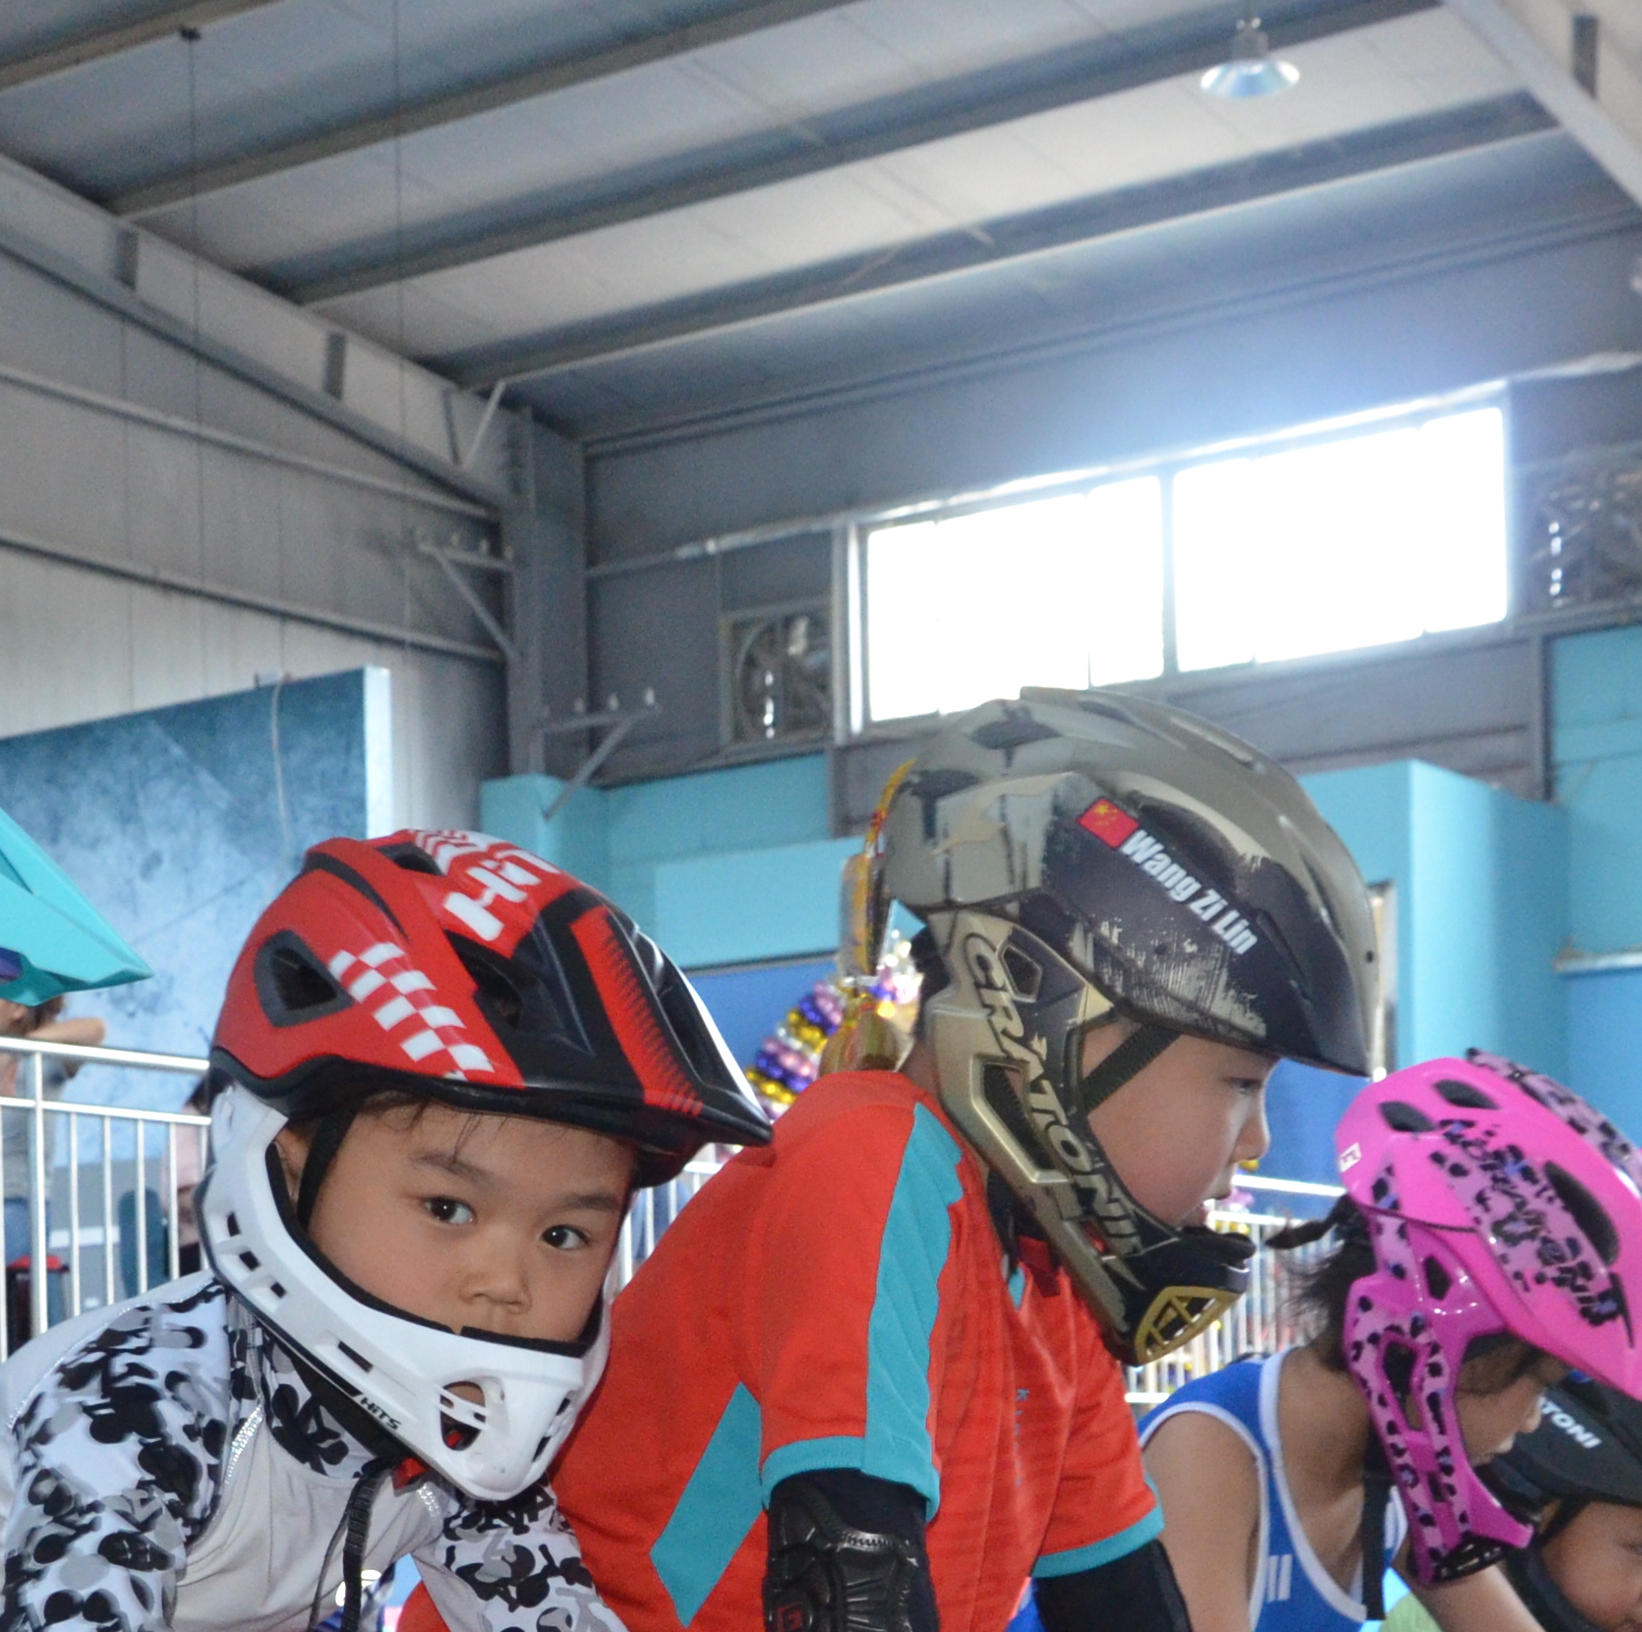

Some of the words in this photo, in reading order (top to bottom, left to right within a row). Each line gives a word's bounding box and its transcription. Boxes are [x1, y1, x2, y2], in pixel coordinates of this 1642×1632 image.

[1121, 829, 1202, 902] Wang
[1189, 888, 1228, 921] Zi
[1211, 909, 1258, 954] Lin
